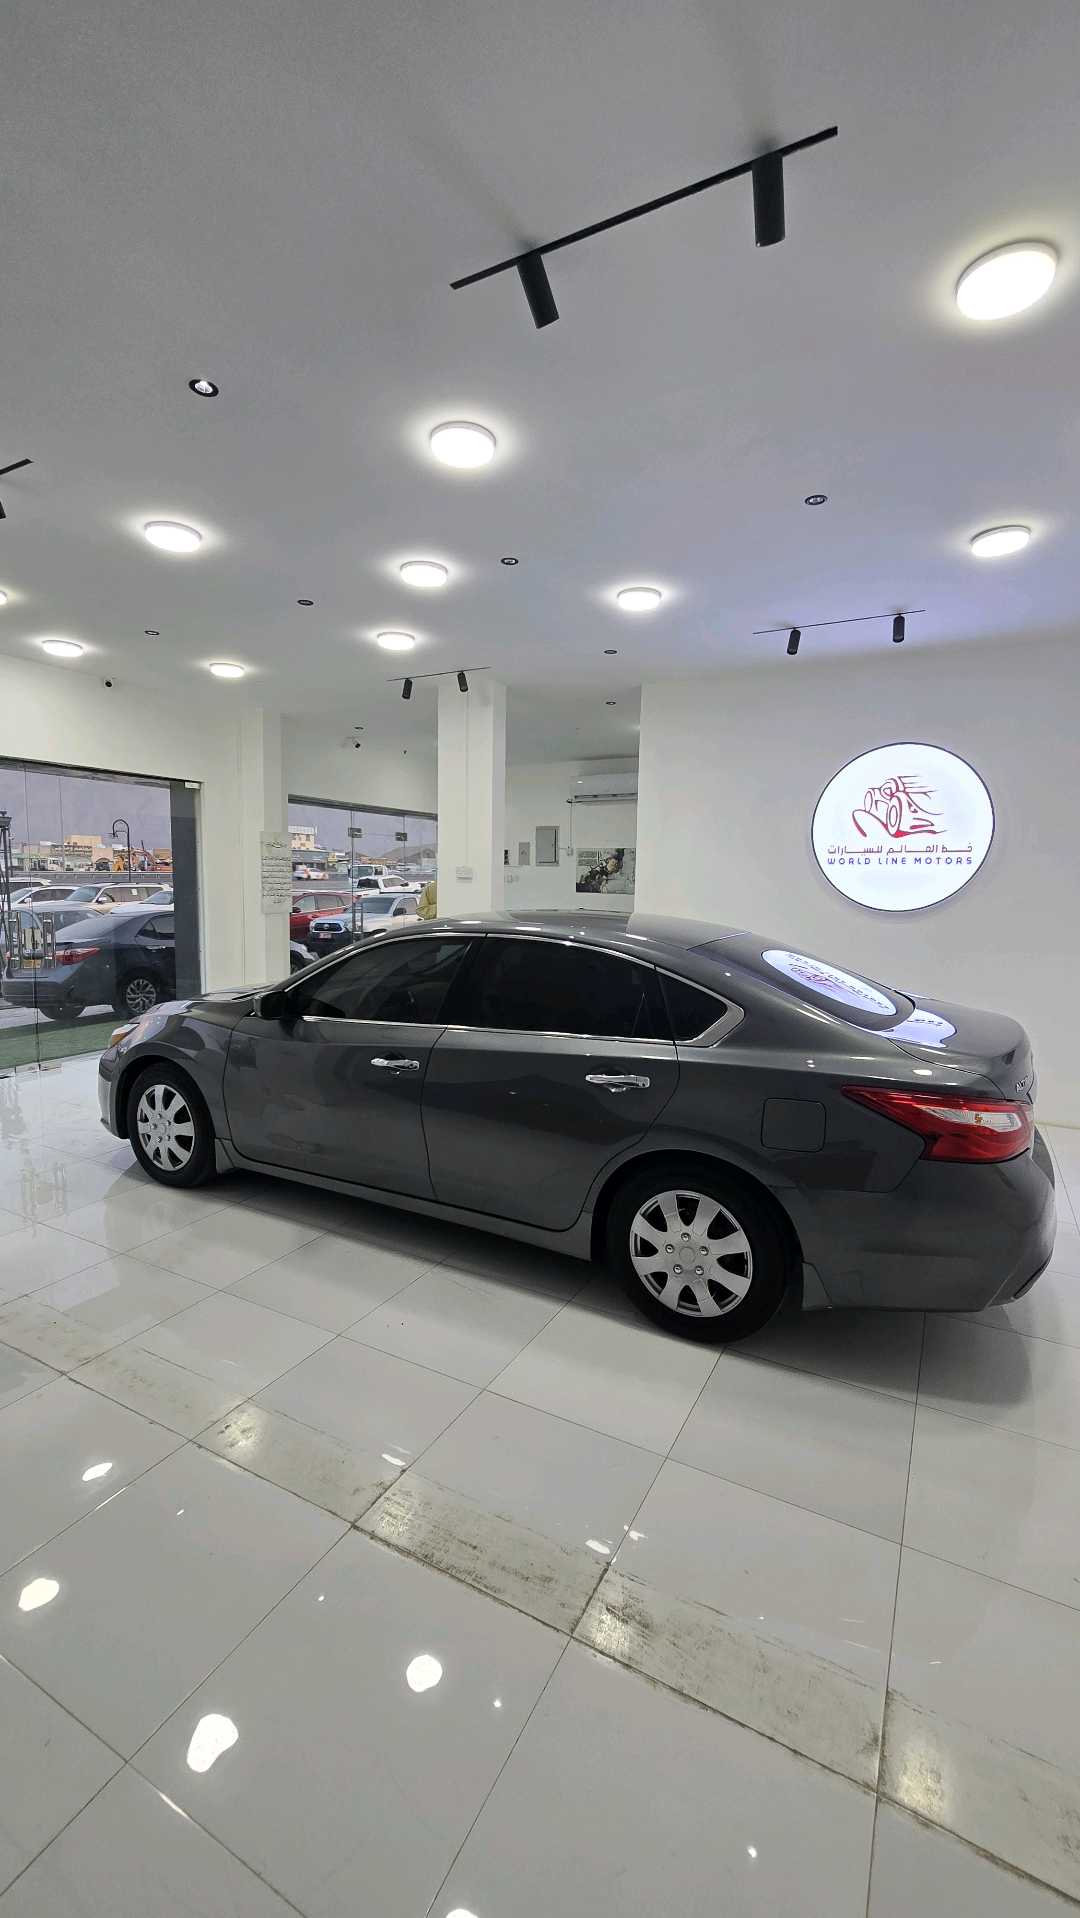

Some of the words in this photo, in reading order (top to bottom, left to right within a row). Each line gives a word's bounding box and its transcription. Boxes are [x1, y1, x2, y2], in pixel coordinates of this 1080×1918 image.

[827, 857, 871, 865] WORLD
[878, 857, 907, 865] LINE
[914, 856, 972, 865] MOTORS
